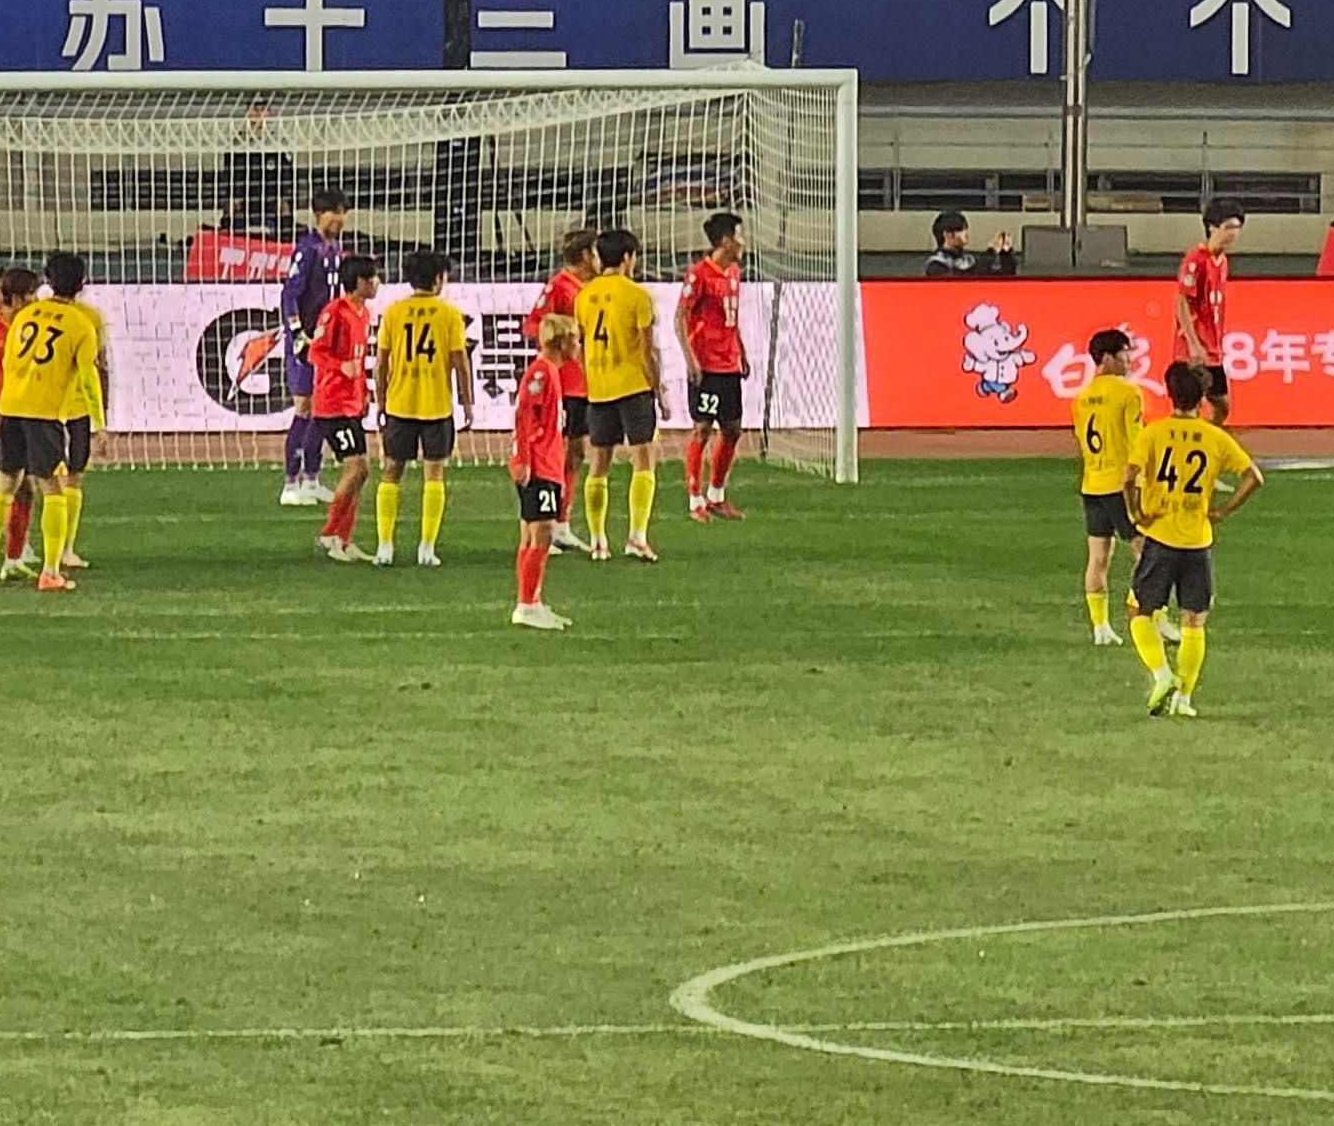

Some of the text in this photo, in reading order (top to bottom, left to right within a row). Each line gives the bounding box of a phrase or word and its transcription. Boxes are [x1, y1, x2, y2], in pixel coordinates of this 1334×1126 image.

[17, 320, 65, 365] 93
[403, 322, 437, 364] 14
[593, 309, 610, 352] 4
[697, 393, 720, 415] 32
[336, 428, 356, 452] 31
[1086, 413, 1103, 454] 6
[1156, 446, 1208, 494] 42
[538, 489, 558, 513] 21
